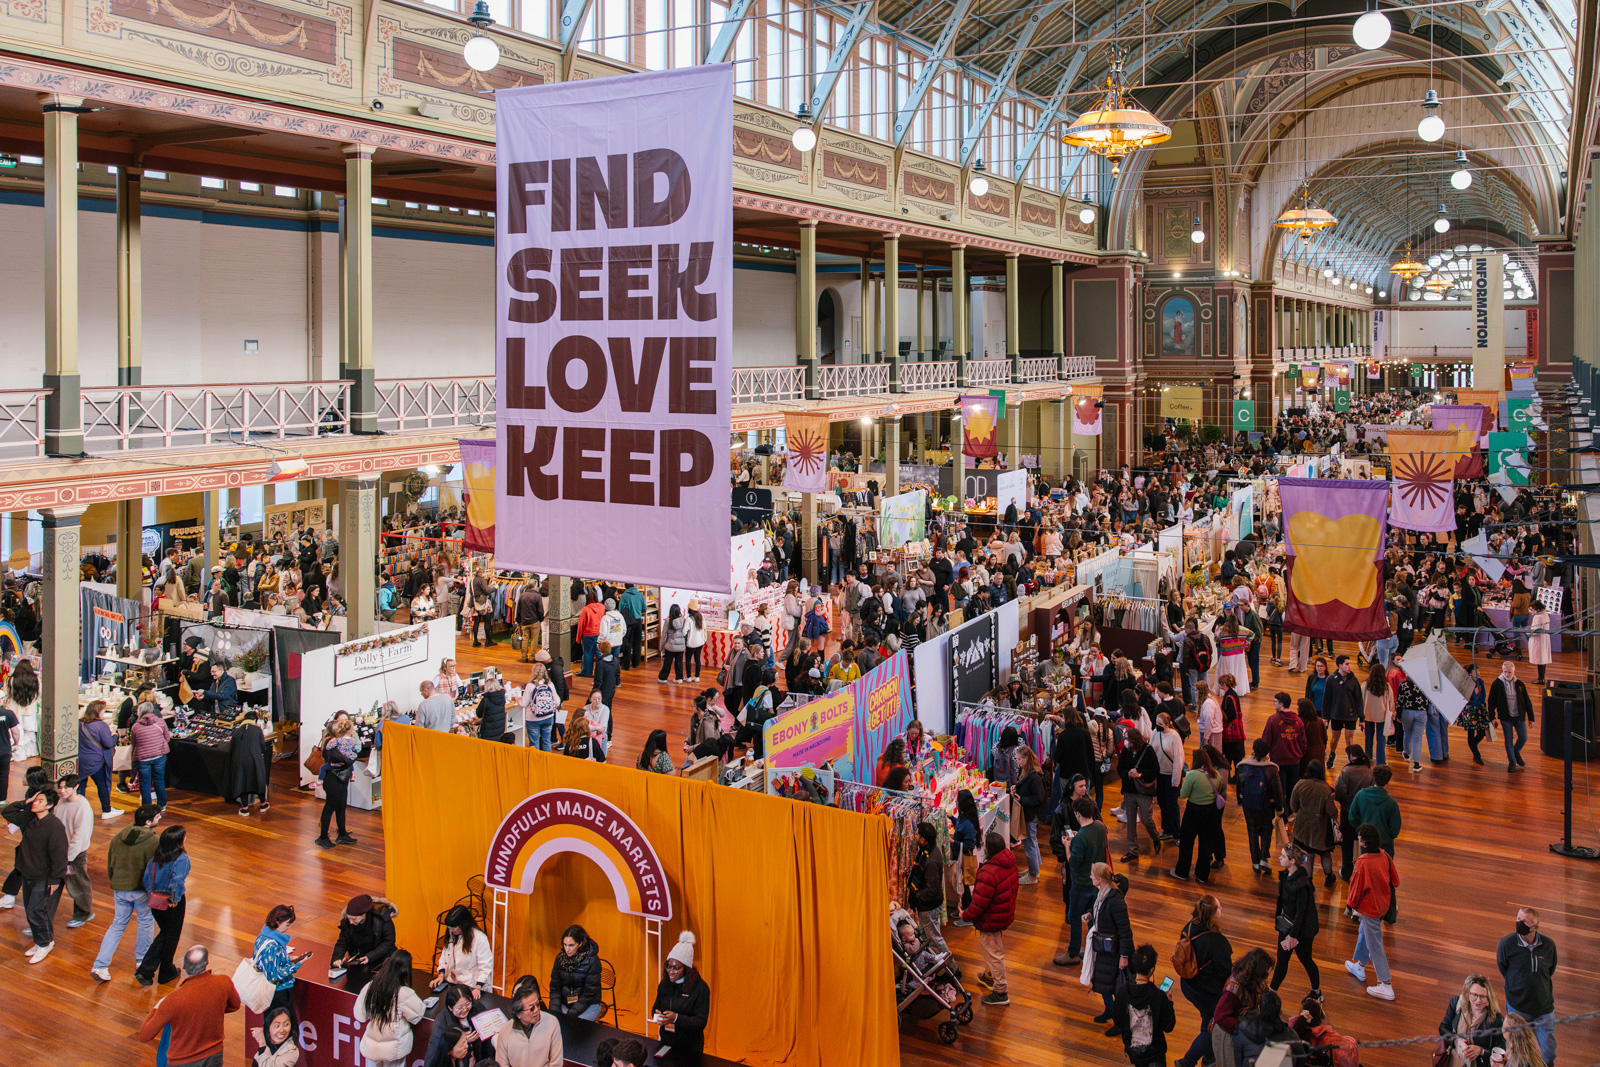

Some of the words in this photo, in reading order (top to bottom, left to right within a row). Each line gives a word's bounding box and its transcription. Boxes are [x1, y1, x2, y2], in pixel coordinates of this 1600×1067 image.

[507, 147, 691, 235] FIND
[506, 240, 718, 324] SEEK
[1475, 257, 1488, 349] INFORMATION
[506, 334, 717, 415] LOVE
[1413, 367, 1420, 375] C
[1237, 408, 1250, 422] C
[1337, 396, 1348, 406] C
[1512, 408, 1527, 422] G
[506, 424, 715, 508] KEEP
[353, 649, 385, 667] Polly's
[387, 644, 413, 657] Farm
[869, 678, 899, 712] CARMEN
[772, 718, 809, 747] EBONY
[820, 701, 849, 724] BOLTS
[871, 703, 885, 728] GET
[793, 747, 805, 758] MADE
[809, 735, 832, 750] MELBOURNE
[493, 802, 551, 883] MINDFULLY
[556, 800, 607, 827] MADE
[607, 820, 662, 911] MARKETS
